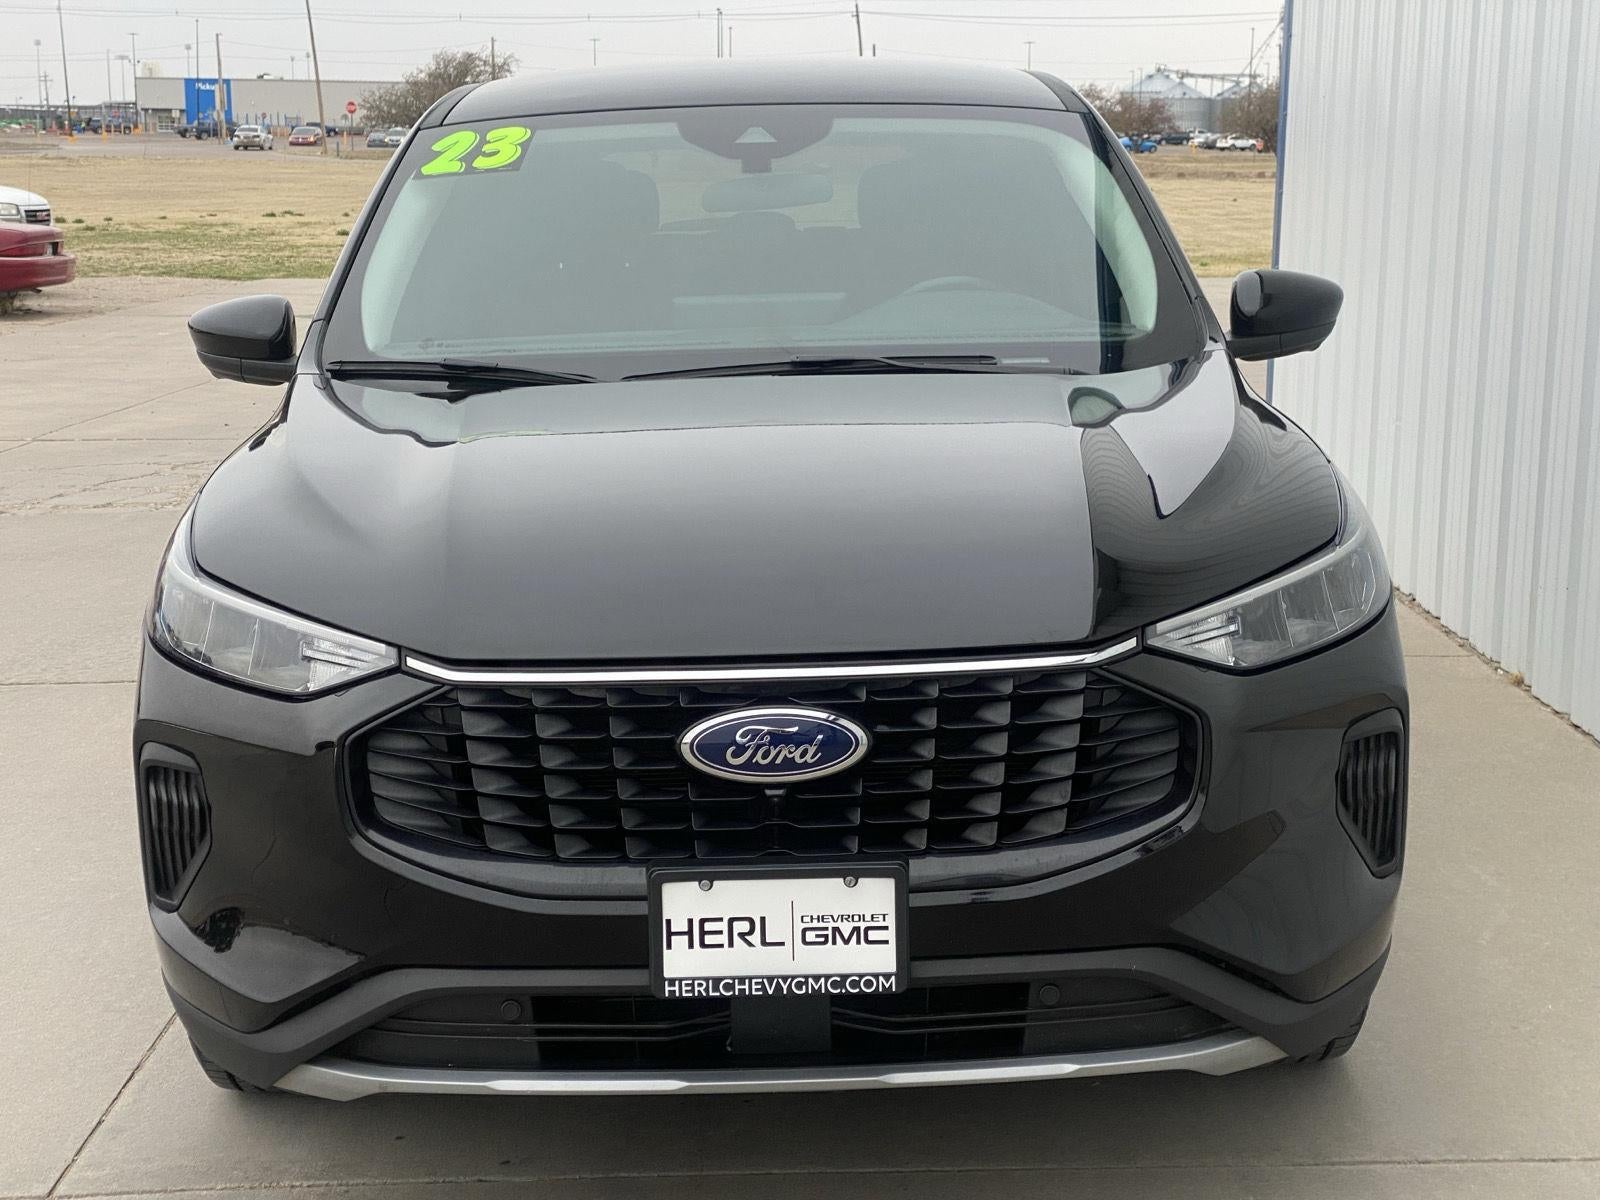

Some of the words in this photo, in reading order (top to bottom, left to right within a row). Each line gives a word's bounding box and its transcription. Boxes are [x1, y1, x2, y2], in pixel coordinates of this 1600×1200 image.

[421, 127, 531, 175] 23
[726, 725, 824, 766] Ford
[801, 913, 889, 924] CHEVROLET
[665, 916, 785, 950] HERL
[801, 926, 889, 946] GMC
[665, 976, 896, 997] HERLCHEVYGMC.COM
